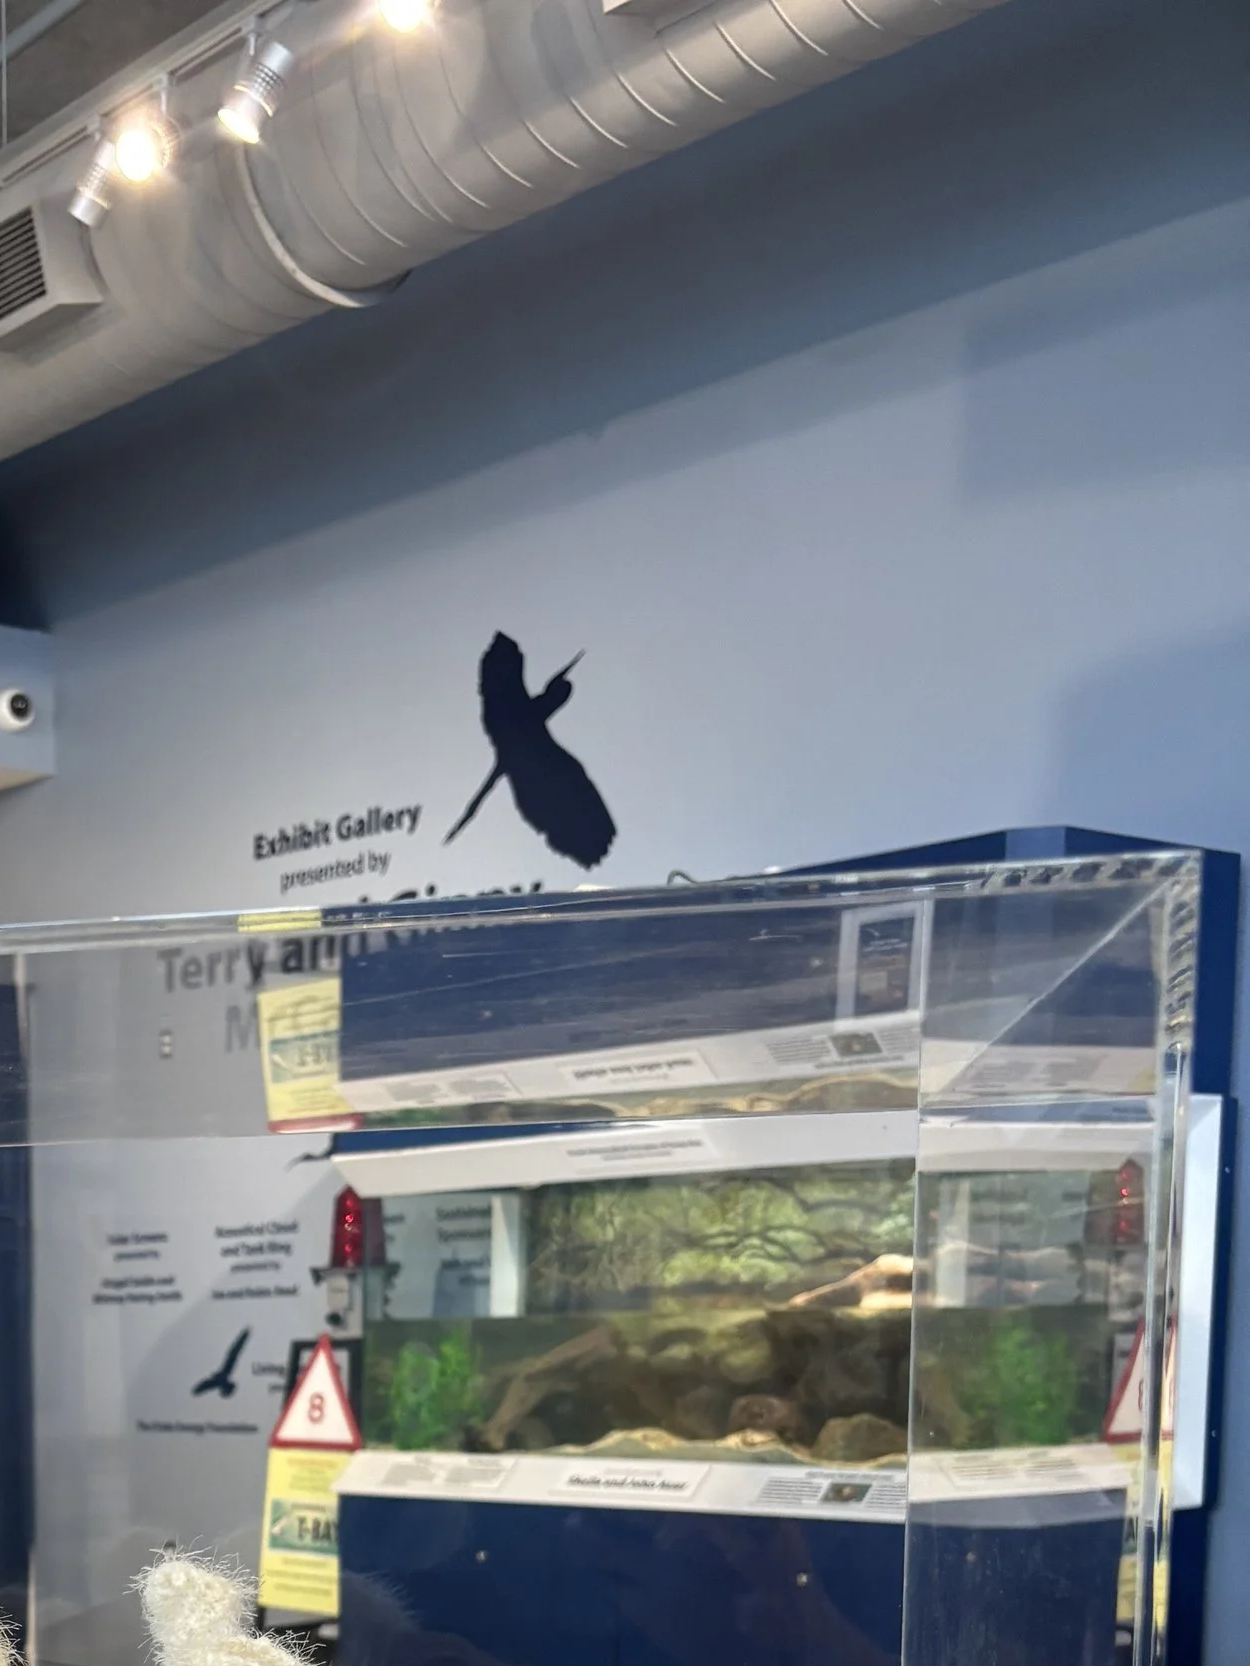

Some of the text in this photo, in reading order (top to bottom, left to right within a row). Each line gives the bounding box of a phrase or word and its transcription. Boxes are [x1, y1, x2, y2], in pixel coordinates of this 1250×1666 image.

[253, 804, 423, 861] Exhibit Gallery
[280, 852, 365, 895] presented
[367, 850, 391, 876] by
[157, 939, 268, 993] Terry
